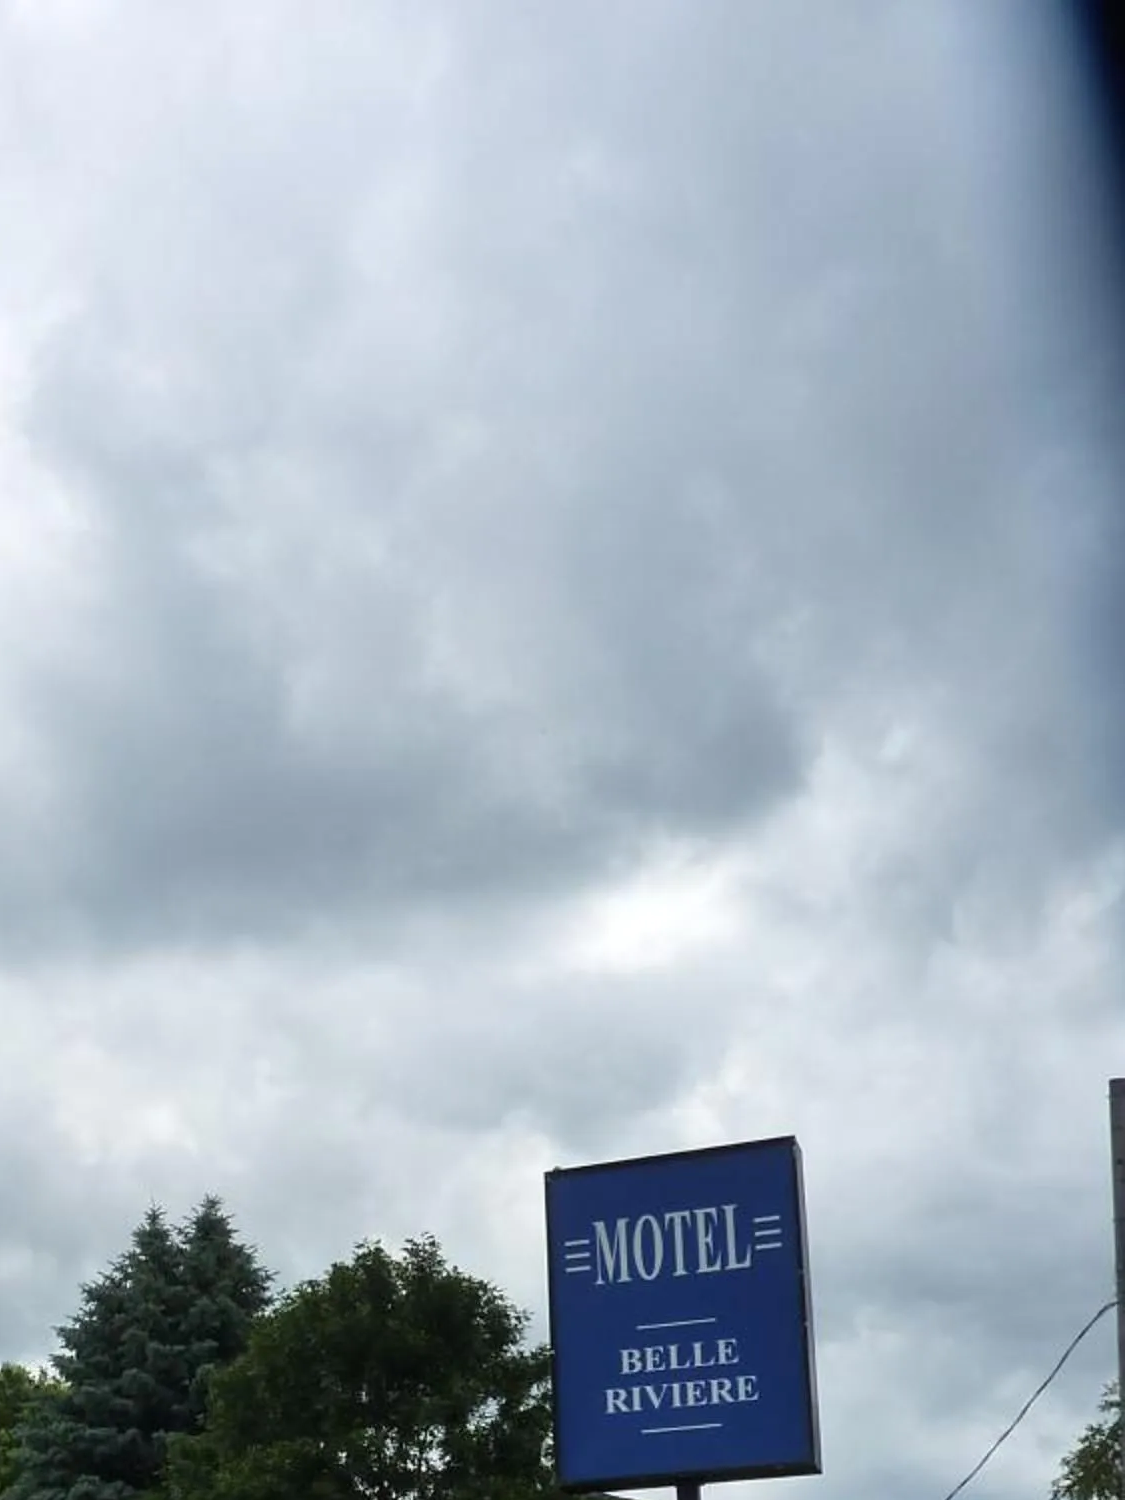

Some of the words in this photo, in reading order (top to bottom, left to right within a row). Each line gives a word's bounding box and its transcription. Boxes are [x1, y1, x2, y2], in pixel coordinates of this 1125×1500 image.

[593, 1204, 751, 1285] MOTEL
[620, 1339, 739, 1375] BELLE
[606, 1376, 759, 1414] RIVIERE
